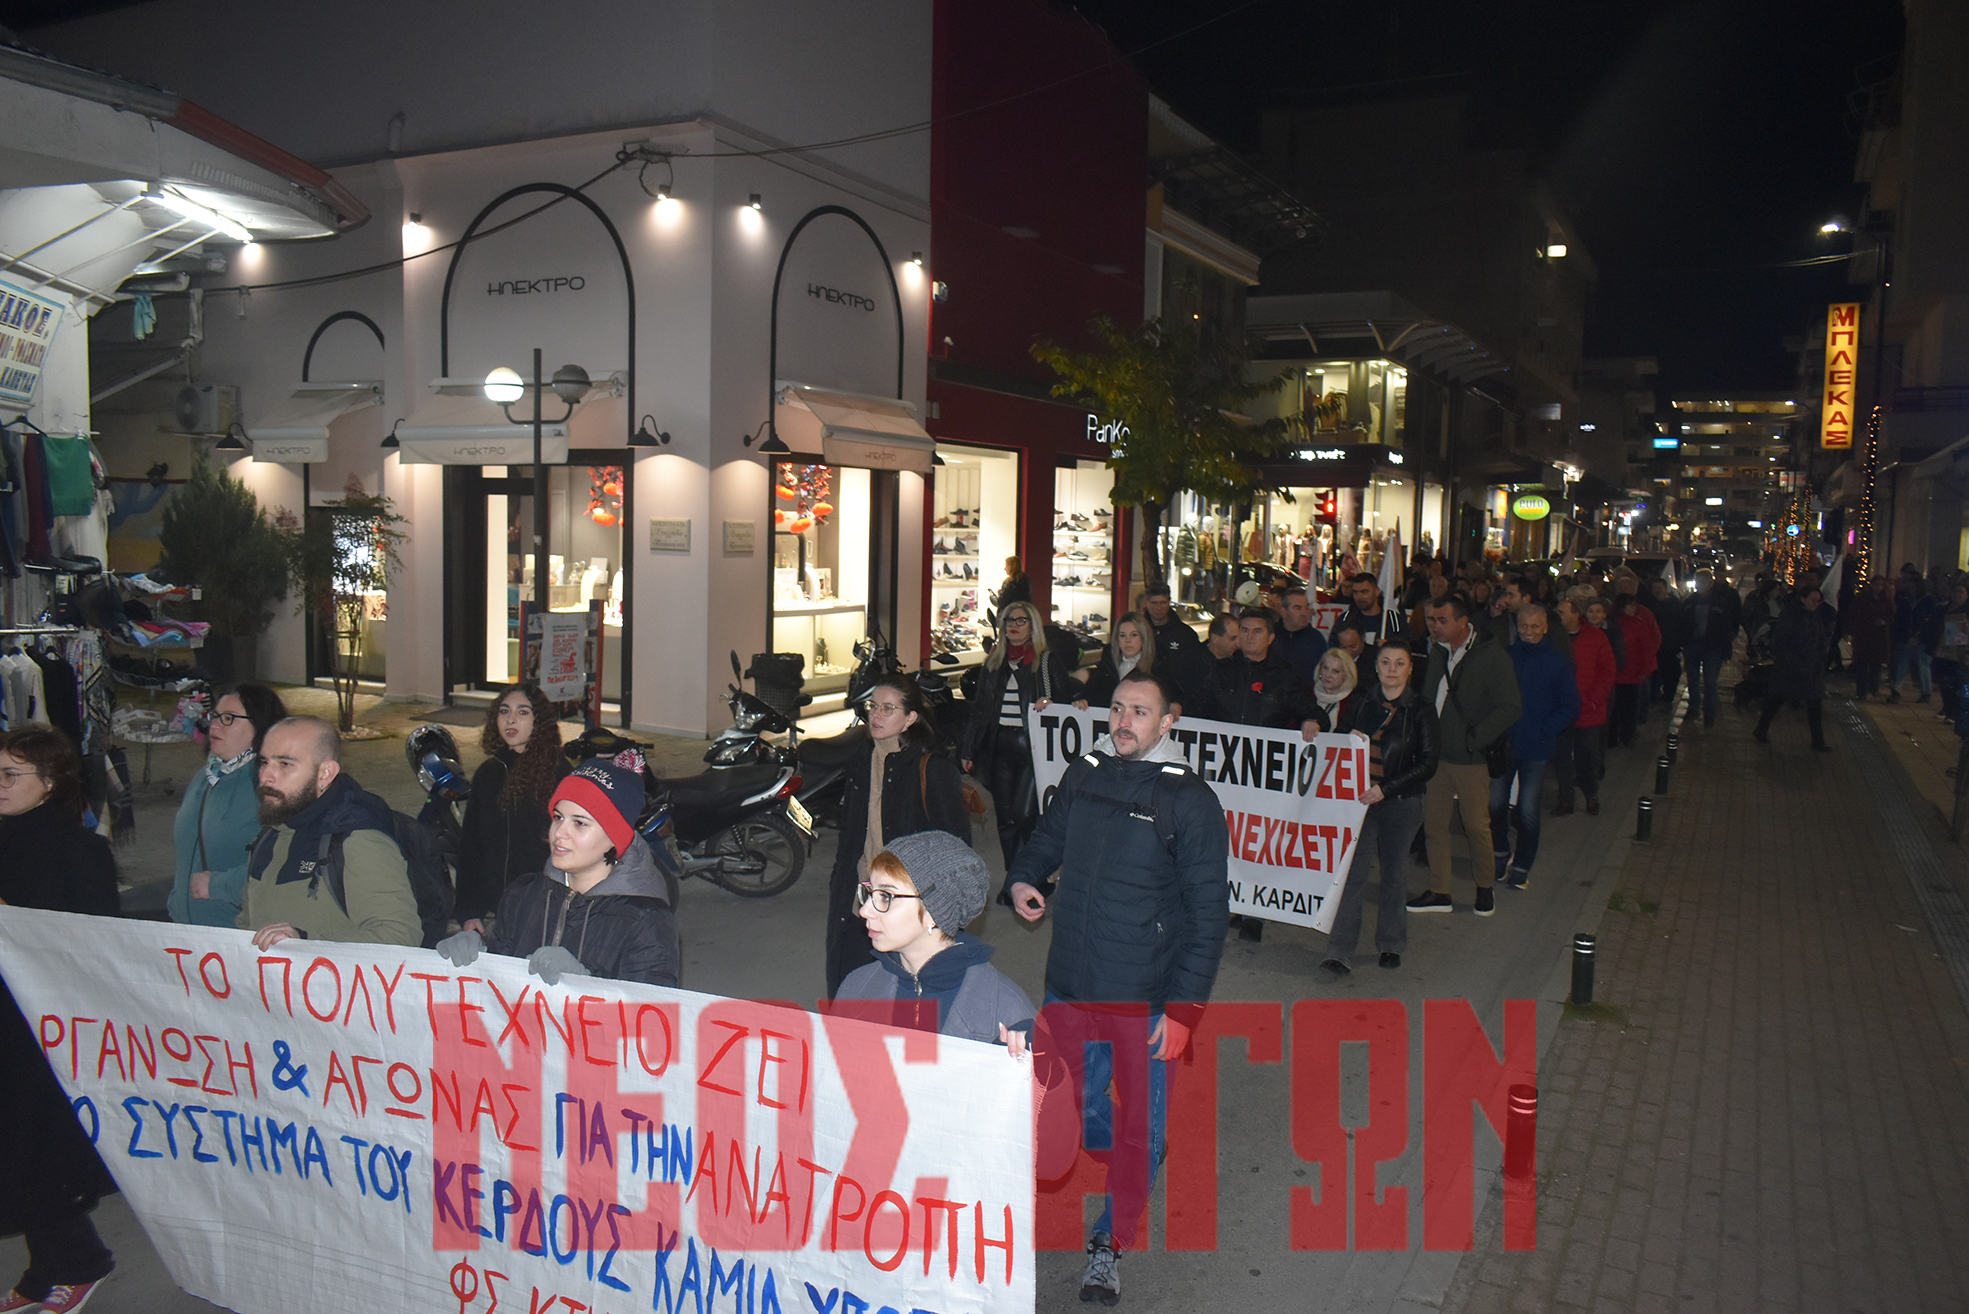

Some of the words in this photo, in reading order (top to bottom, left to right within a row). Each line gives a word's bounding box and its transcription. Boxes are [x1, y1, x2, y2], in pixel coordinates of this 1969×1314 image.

[0, 289, 53, 340] ΑΚΟΣ.
[1825, 305, 1856, 446] ΜΠΛΕΚΑΣ
[1519, 499, 1544, 509] euro
[1040, 715, 1082, 766] ΤΟ
[1093, 719, 1317, 798] ΤΕΧΝΕΙΟ
[1315, 746, 1367, 801] ΖΕΙ
[1222, 808, 1352, 874] ΝΕΧΙΖΕΤ
[164, 947, 232, 999] ΤΟ
[256, 955, 673, 1080] ΠΟΛΥΤΕΧΝΕΙΟ
[696, 1019, 809, 1116] ΖΕΙ
[121, 1095, 334, 1188] ΣΥΣΤΗΜΑ
[339, 1134, 413, 1215] ΤΟΥ
[433, 1157, 632, 1293] ΚΕΡΔΟΥΣ
[271, 1039, 310, 1099] &
[555, 1092, 614, 1170] ΓΙΑ
[620, 1108, 693, 1187] ΤΗΝ
[684, 1130, 1015, 1287] ΑΝΑΤΡΟΠΗ
